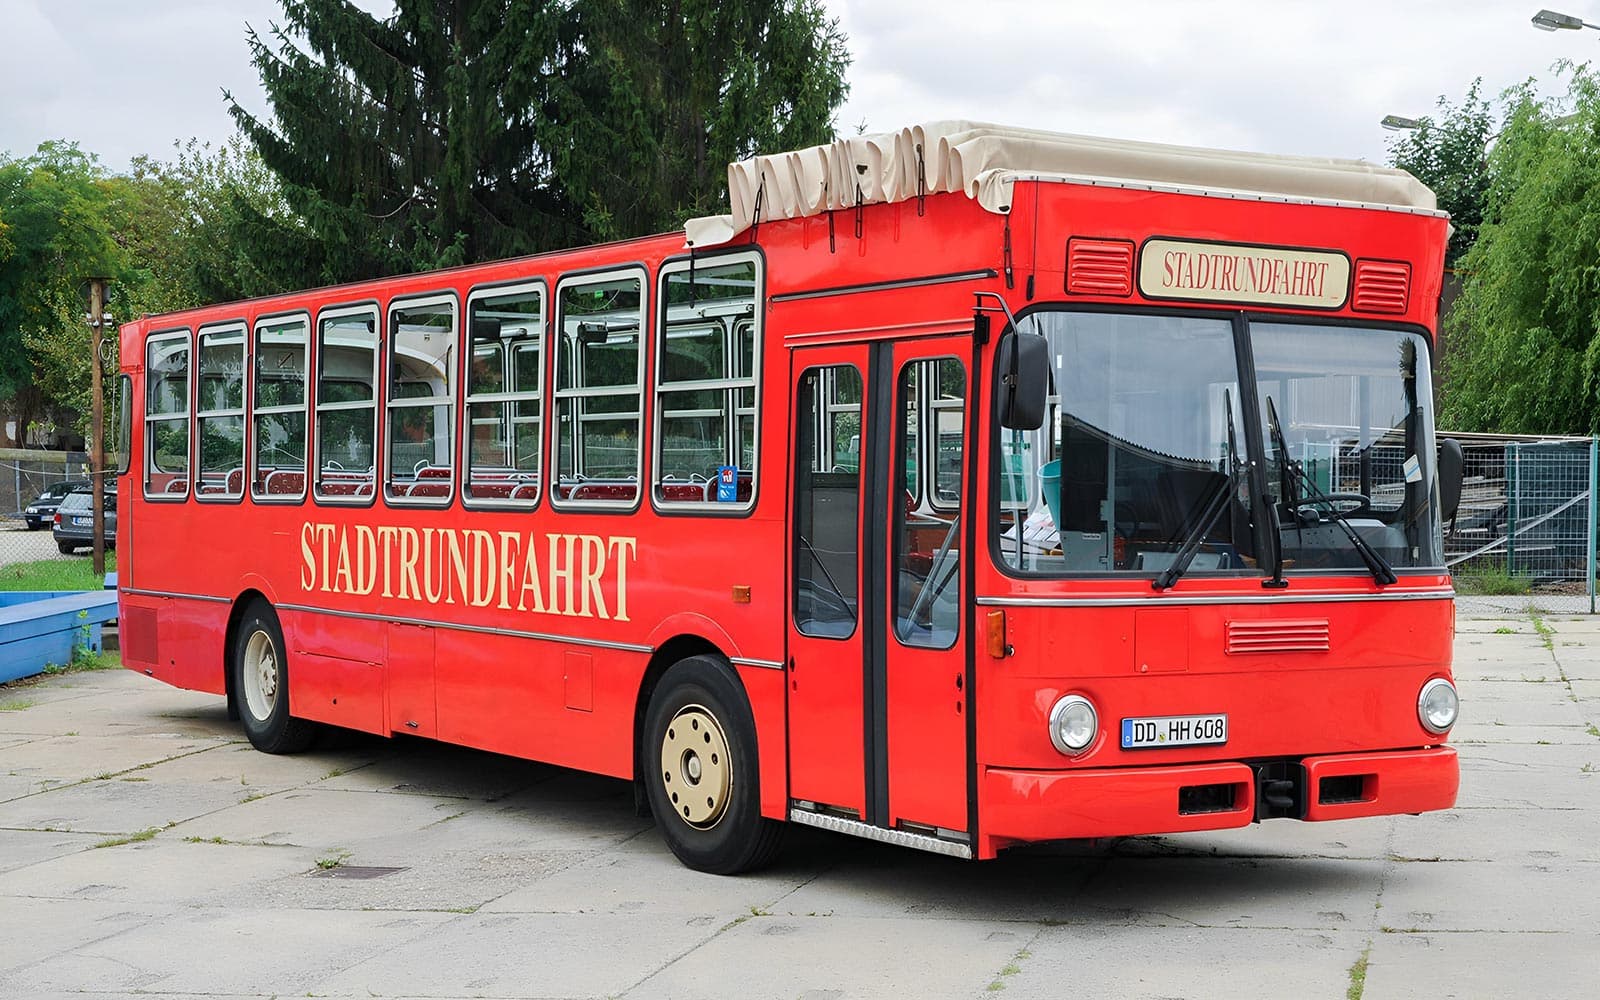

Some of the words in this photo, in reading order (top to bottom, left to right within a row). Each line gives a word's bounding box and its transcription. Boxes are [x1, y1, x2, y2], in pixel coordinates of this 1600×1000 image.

[1162, 250, 1329, 298] STADTRUNDFAHRT
[301, 521, 637, 622] STADTRUNDFAHRT
[1134, 722, 1157, 742] DD
[1168, 720, 1190, 741] HH
[1194, 719, 1224, 739] 608
